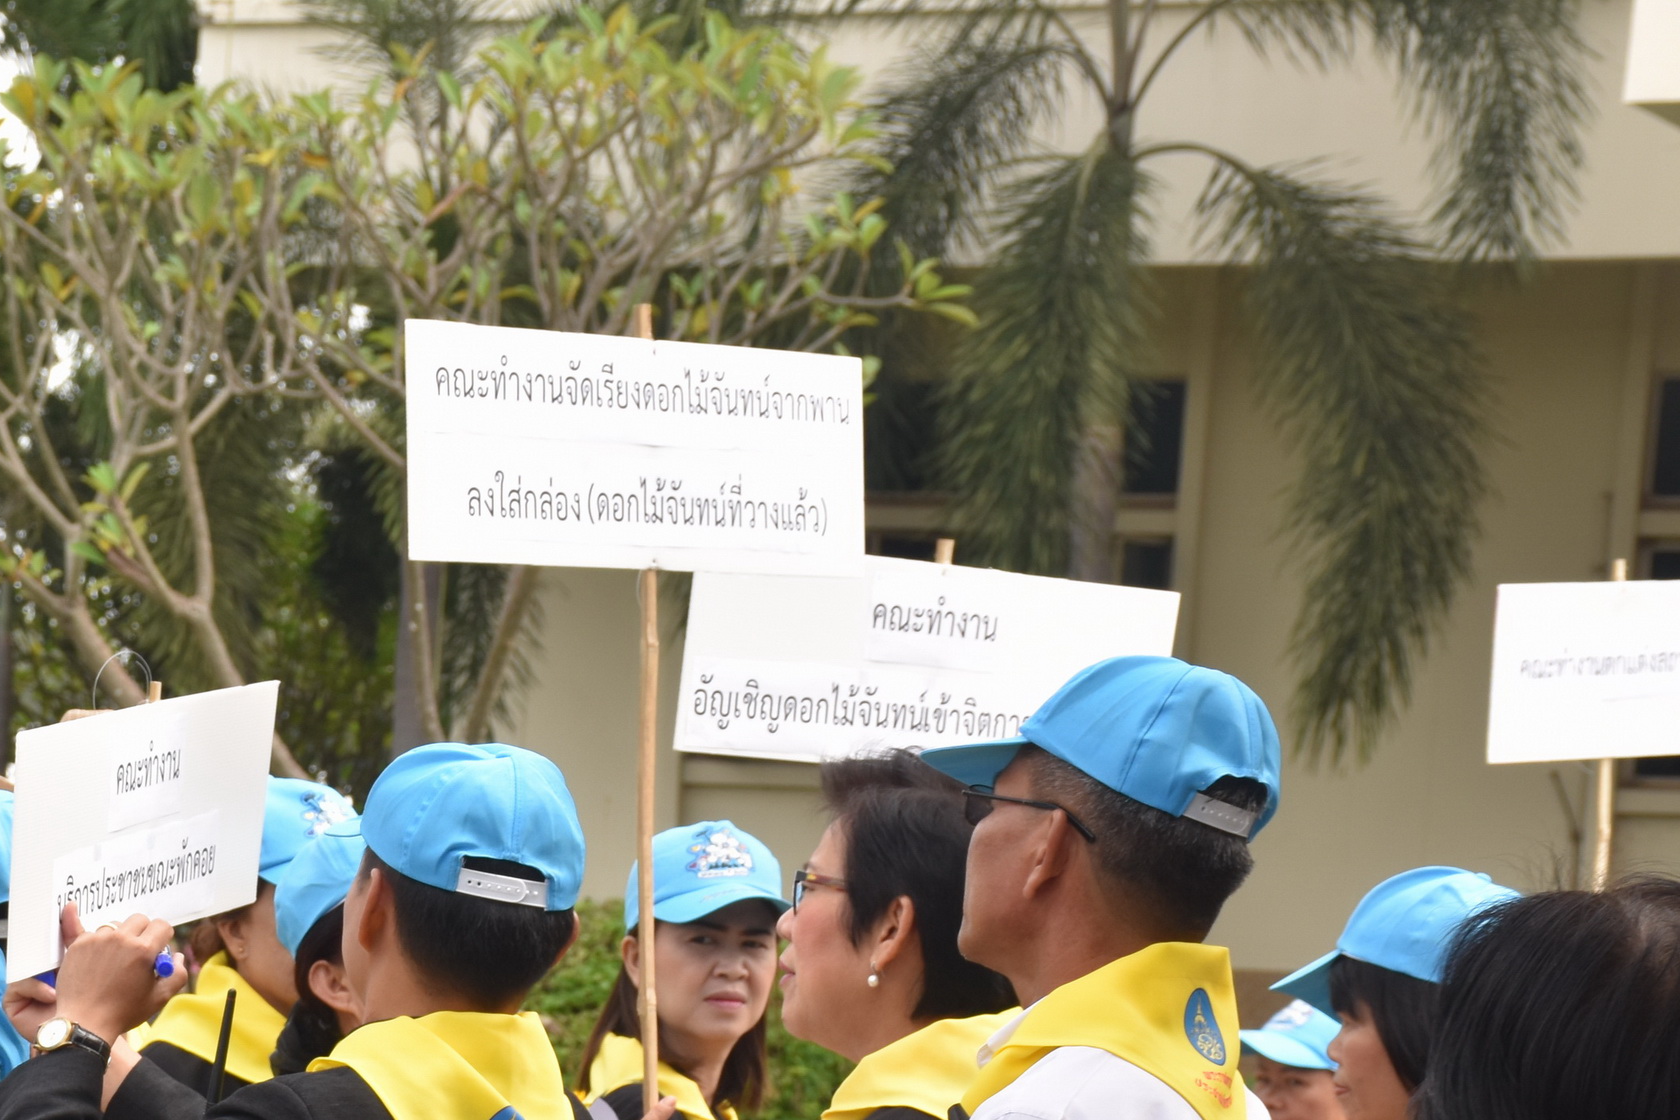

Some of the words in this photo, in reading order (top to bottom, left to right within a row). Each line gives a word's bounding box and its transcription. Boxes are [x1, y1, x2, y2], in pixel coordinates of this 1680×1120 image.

[435, 355, 850, 426] คณะทำงานจัดเรียงดอกไม้จันทน์จากพาน
[871, 596, 998, 643] คณะทำงาน
[693, 674, 1030, 739] อัญเชิญดอกไม้จันทน์เข้าจิตกา
[116, 740, 181, 795] คณะทำงาน
